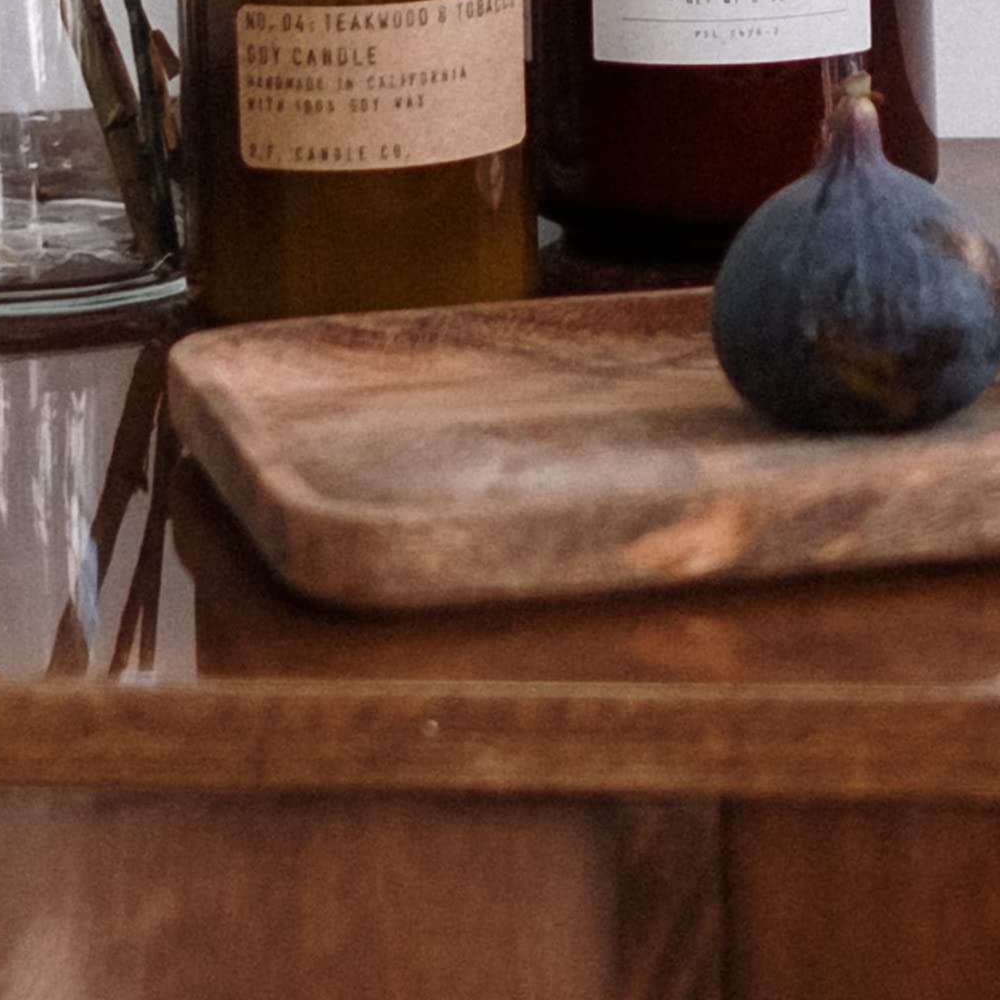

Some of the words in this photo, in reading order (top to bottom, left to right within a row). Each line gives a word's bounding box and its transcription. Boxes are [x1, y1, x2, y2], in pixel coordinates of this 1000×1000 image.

[324, 7, 429, 32] TEAKWOOD
[292, 46, 377, 66] CANDLE
[367, 66, 467, 90] CALIFORNIA
[295, 144, 368, 161] CANDLE
